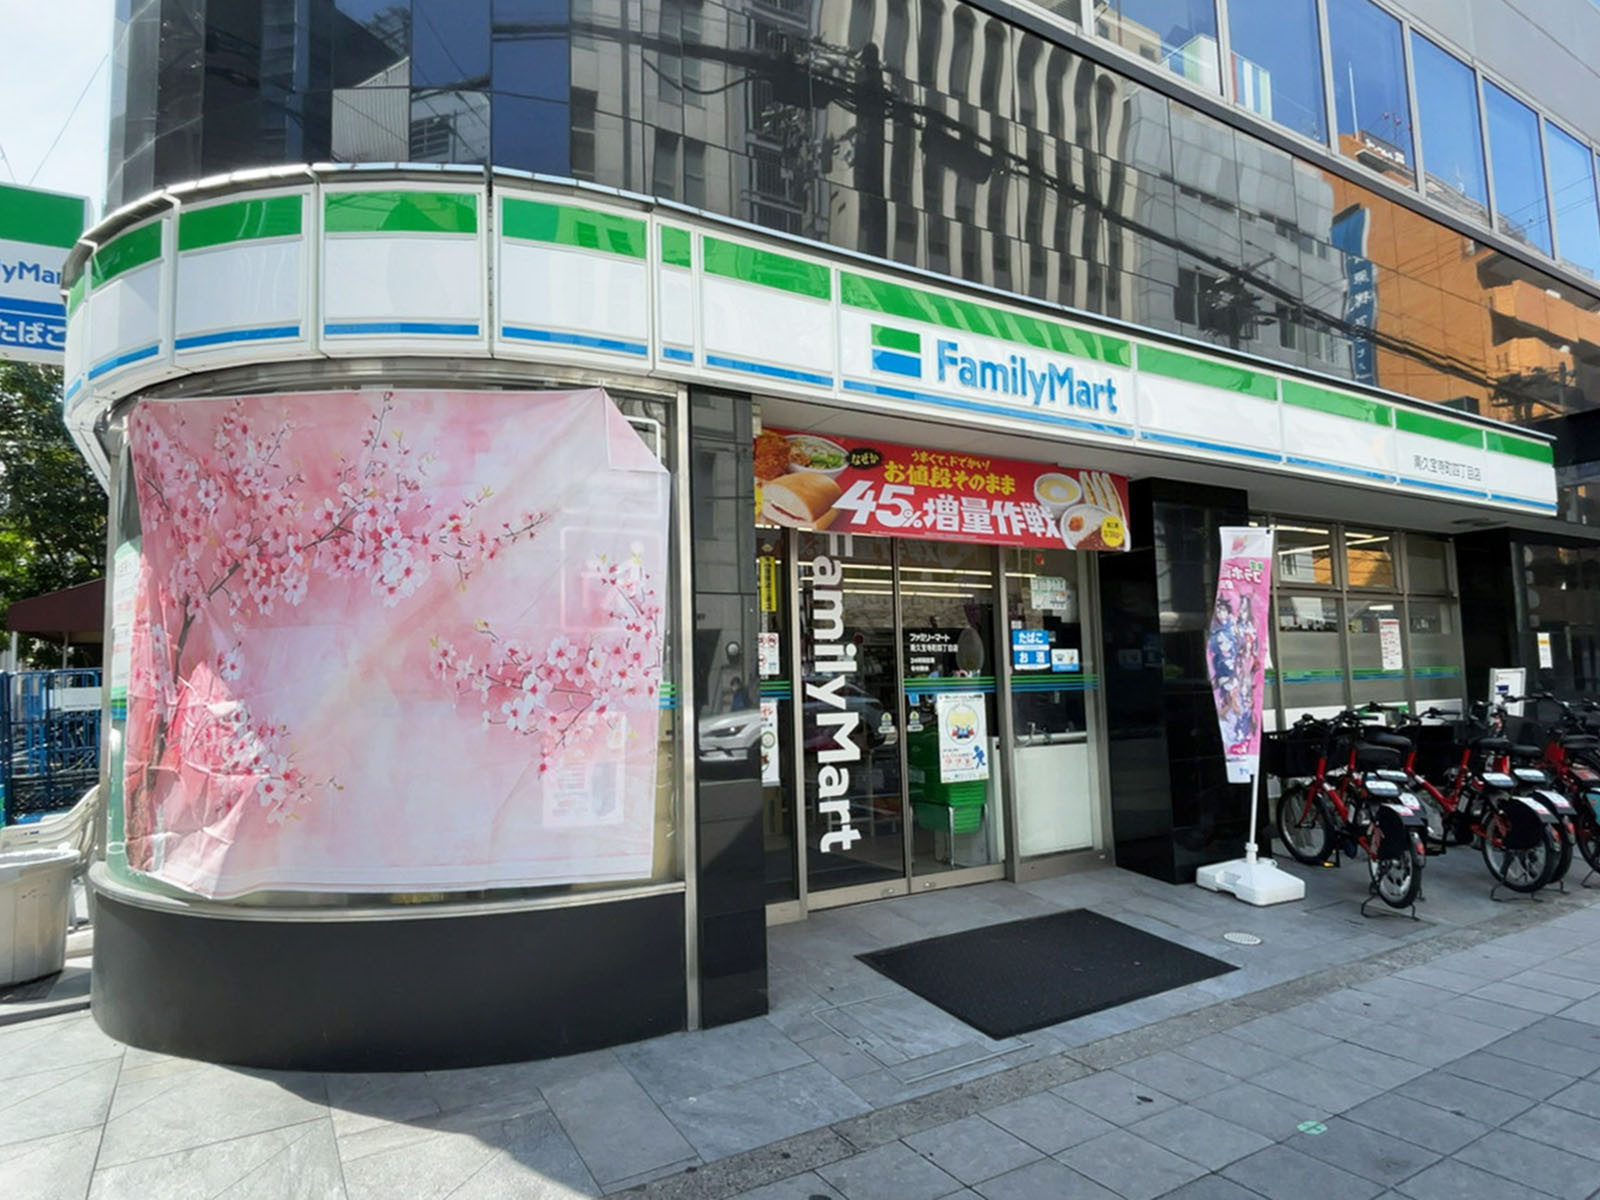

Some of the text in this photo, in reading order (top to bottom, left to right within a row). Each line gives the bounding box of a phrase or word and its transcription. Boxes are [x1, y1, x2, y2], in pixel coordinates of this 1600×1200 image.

[937, 339, 1118, 414] FamilyMart
[884, 461, 1016, 495] お値段そのまま
